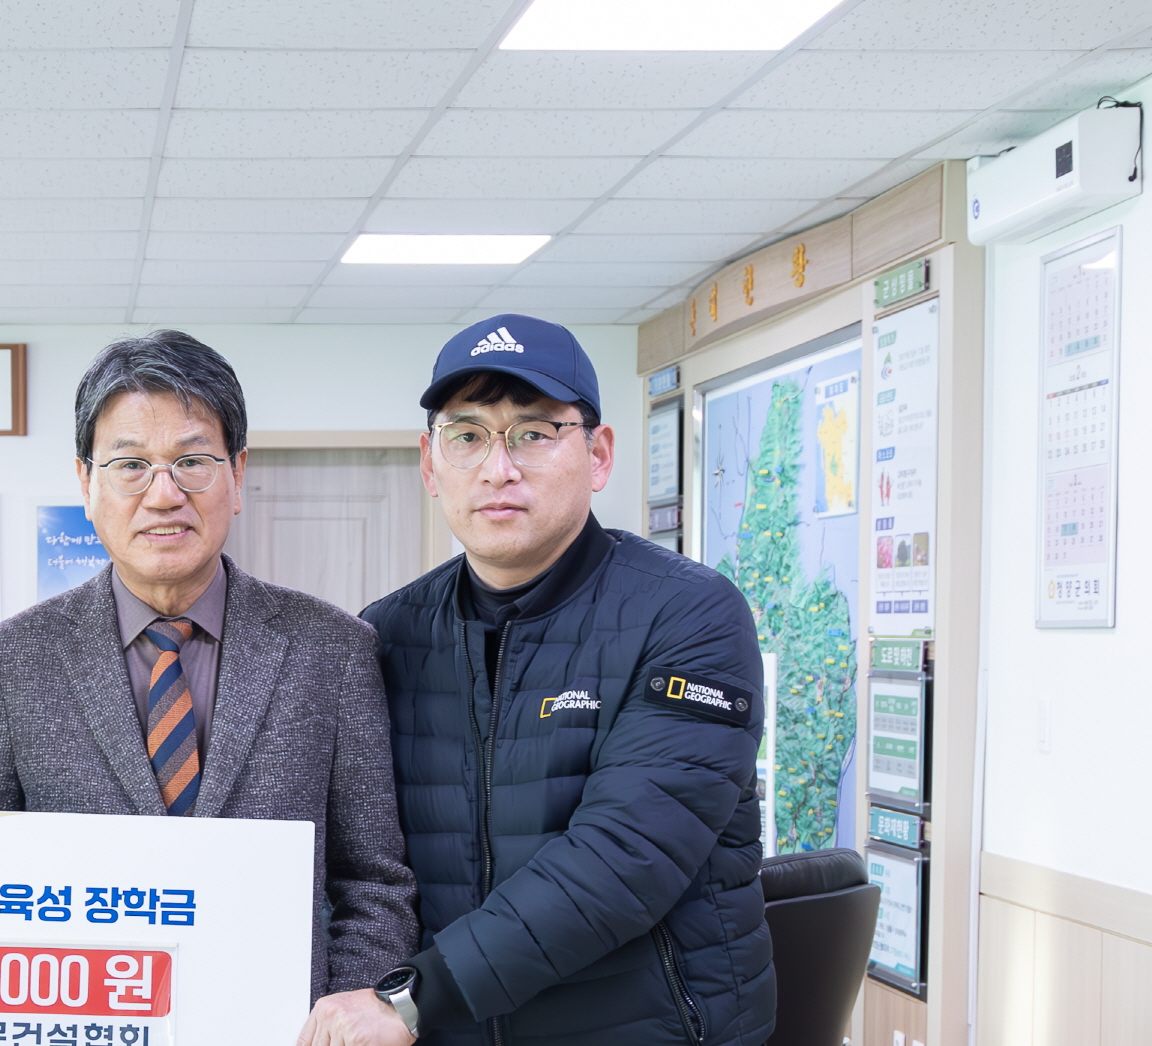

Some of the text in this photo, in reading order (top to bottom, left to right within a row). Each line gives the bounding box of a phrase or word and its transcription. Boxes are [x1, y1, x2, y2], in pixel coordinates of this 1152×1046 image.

[470, 341, 524, 356] adidas
[45, 531, 83, 546] 다함께
[48, 554, 74, 570] 더불어
[1056, 578, 1100, 599] 청양군의회
[686, 682, 725, 699] NATIONAL
[684, 691, 733, 711] GEOGRAPHIC
[878, 815, 910, 840] 문화재현황
[85, 887, 197, 926] 장학금
[103, 954, 152, 1012] 원
